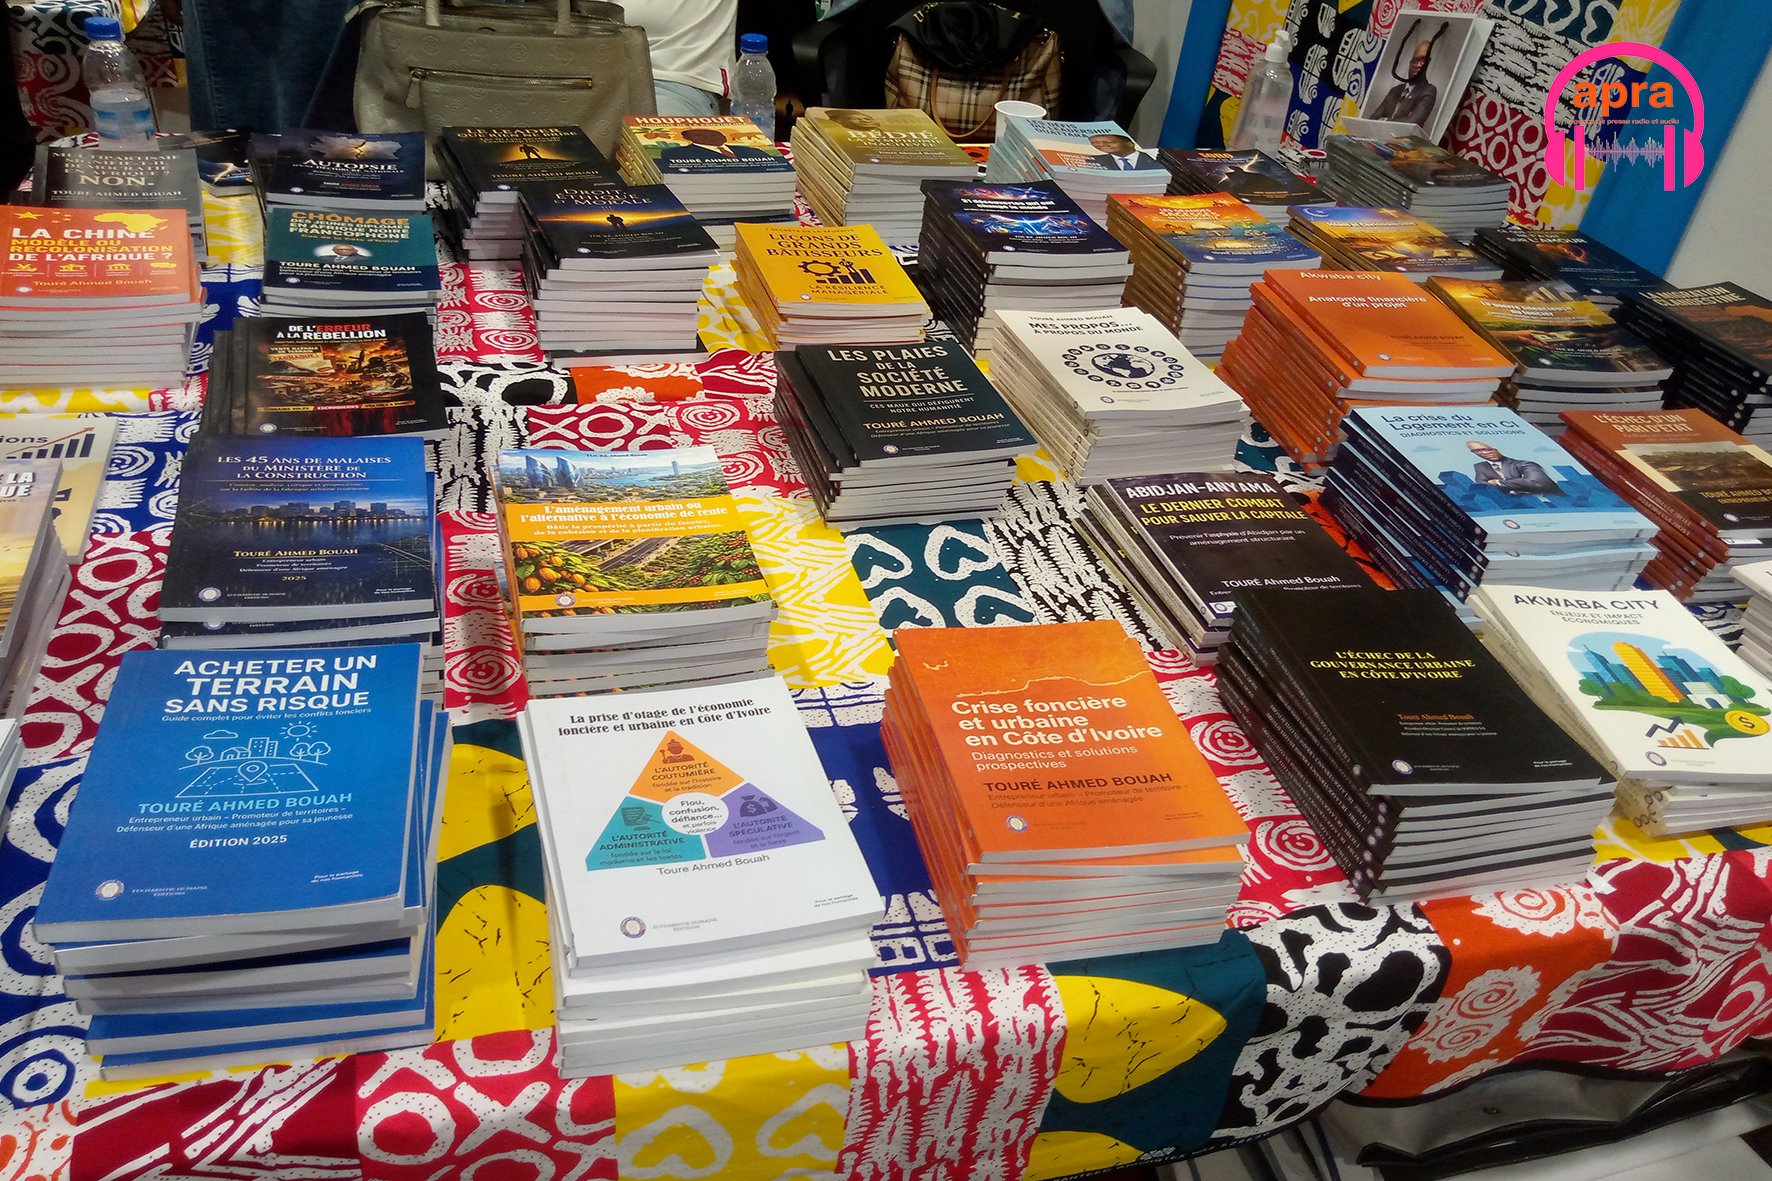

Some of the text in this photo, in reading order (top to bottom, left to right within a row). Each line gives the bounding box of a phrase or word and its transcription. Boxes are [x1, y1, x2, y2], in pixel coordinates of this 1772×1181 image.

[846, 130, 938, 140] BÉDIÉ
[303, 159, 397, 170] AUTOPSIE
[79, 175, 154, 186] NON.
[292, 211, 409, 225] CHÔMAGE
[289, 227, 409, 239] FRANCOPHONE
[310, 223, 365, 232] AFRIQUE
[12, 228, 155, 239] LA CHINE
[769, 233, 834, 242] LEÇONS
[777, 240, 861, 249] GRANDS
[9, 253, 38, 261] DE
[46, 253, 155, 261] L'AFRIQUE
[1300, 272, 1382, 281] Akwaba city
[1371, 301, 1408, 309] projet
[307, 324, 371, 332] L'ERREUR
[1029, 322, 1059, 331] MES
[1105, 326, 1144, 335] MONDE
[277, 331, 284, 339] À
[287, 331, 300, 339] LA
[826, 345, 948, 363] LES PLAIES
[875, 362, 895, 370] DE
[856, 366, 949, 384] SOCIÉTÉ
[859, 379, 968, 397] MODERNE
[863, 413, 1004, 430] TOURÉ AHMED BOUAH
[1381, 413, 1473, 423] La crise du
[1592, 413, 1687, 424] L'ÉCHEC D'UN
[1390, 420, 1475, 432] Logement
[1611, 422, 1693, 433] PARI D'ÉTAT
[263, 464, 342, 472] MINISTÈRE
[255, 471, 367, 479] CONSTRUCTION
[544, 505, 641, 515] L'aménagement
[644, 502, 683, 512] urbain
[1140, 498, 1285, 514] LE DERNIER COMBAT
[520, 513, 597, 522] l'alternative
[612, 511, 676, 521] l'économie
[679, 509, 695, 518] de
[698, 507, 728, 515] rente
[1140, 510, 1308, 525] POUR SAUVER LA CAPITALE
[233, 549, 271, 557] TOURÉ
[1513, 593, 1661, 611] AKWABA CITY
[1550, 610, 1587, 618] ENJEUX
[1562, 616, 1640, 625] ÉCONOMIQUES
[1335, 650, 1394, 660] L'ÉCHEC
[1394, 652, 1414, 660] DE
[174, 655, 378, 675] ACHETER UN
[1310, 660, 1476, 669] GOUVERNANCE URBAINE
[1338, 669, 1463, 679] EN CÔTE D'IVOIRE
[186, 672, 358, 696] TERRAIN
[164, 691, 370, 714] SANS RISQUE
[951, 695, 1128, 715] Crise foncière
[570, 698, 754, 725] La prise d'otage de l'économie
[558, 705, 772, 736] foncière et urbaine en Côte d'Ivoire
[958, 713, 1089, 730] et urbaine
[964, 724, 1163, 747] en Côte d'Ivoire
[971, 744, 1138, 762] Diagnostics et solutions
[975, 760, 1067, 773] prospectives
[189, 835, 288, 849] ÉDITION 2025
